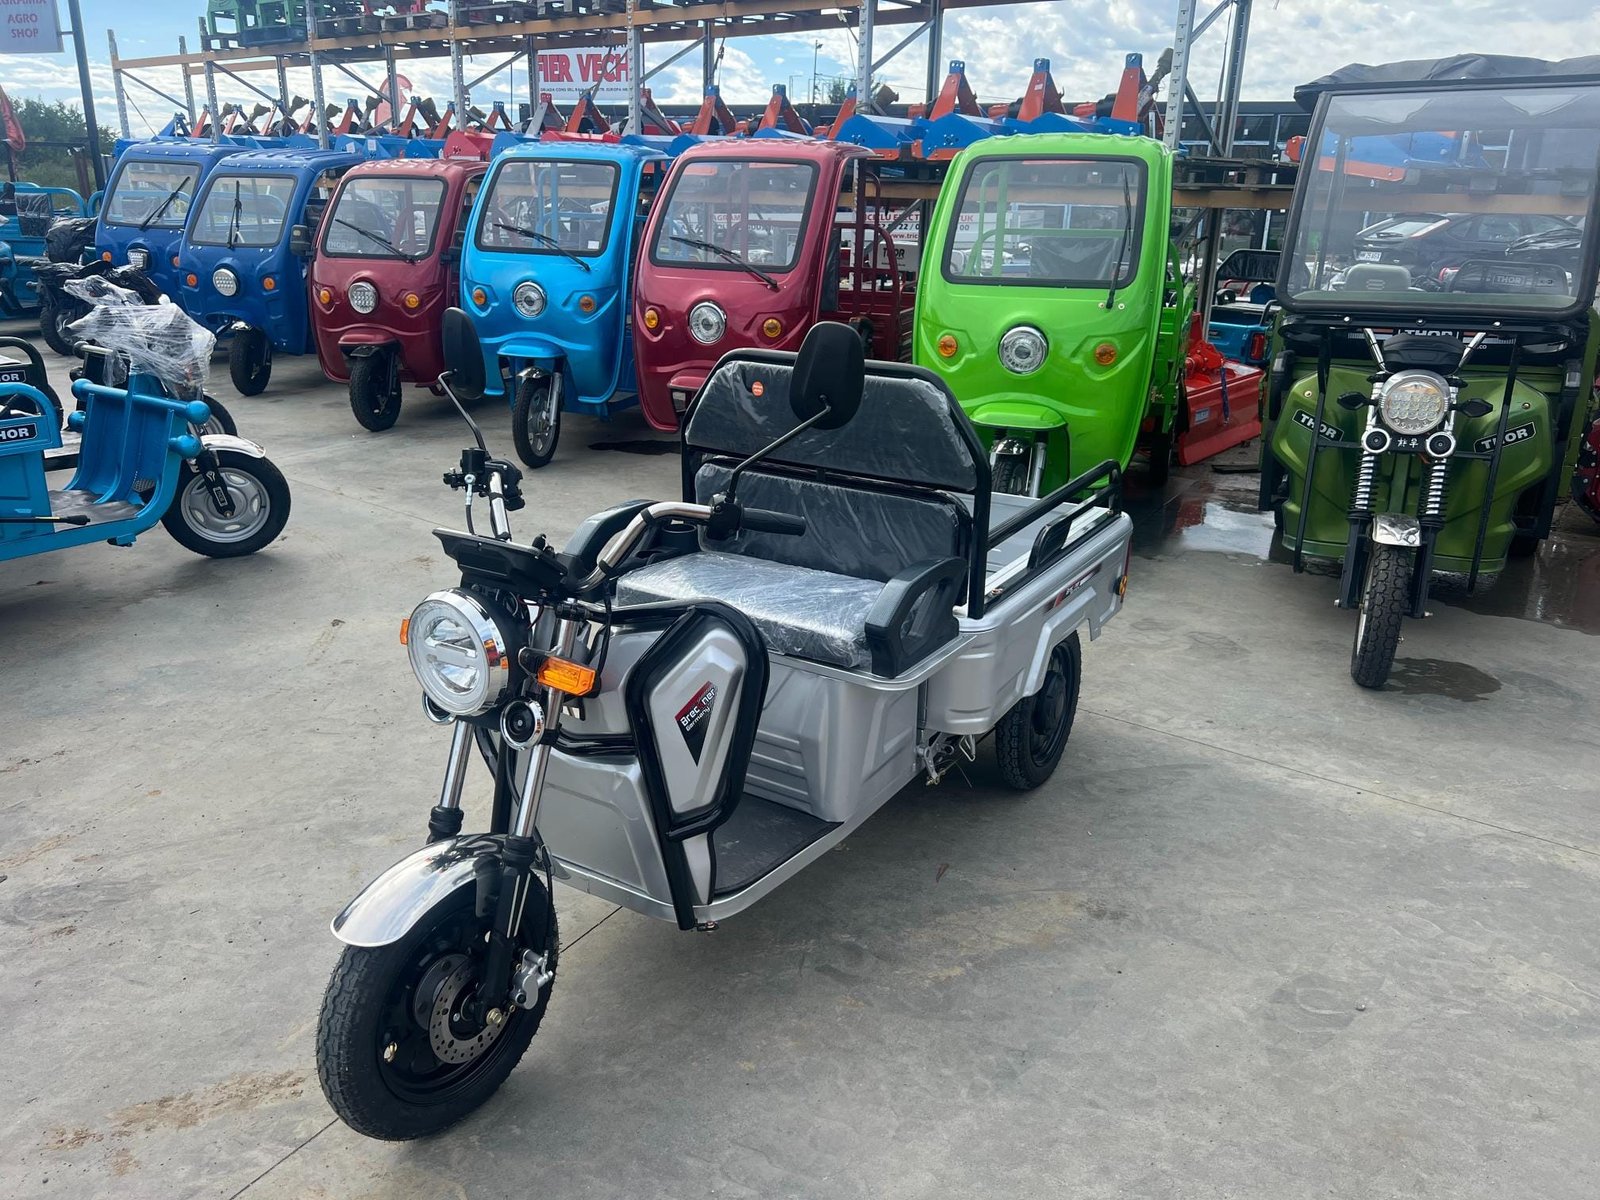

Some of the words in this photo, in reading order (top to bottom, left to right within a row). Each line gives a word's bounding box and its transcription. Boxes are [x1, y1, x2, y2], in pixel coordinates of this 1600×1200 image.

[8, 13, 38, 24] AGRO
[11, 28, 39, 38] SHOP
[883, 247, 905, 258] TOR
[1496, 275, 1523, 285] THOR
[0, 373, 20, 382] OR
[0, 427, 30, 440] HOR
[685, 706, 711, 732] Germany
